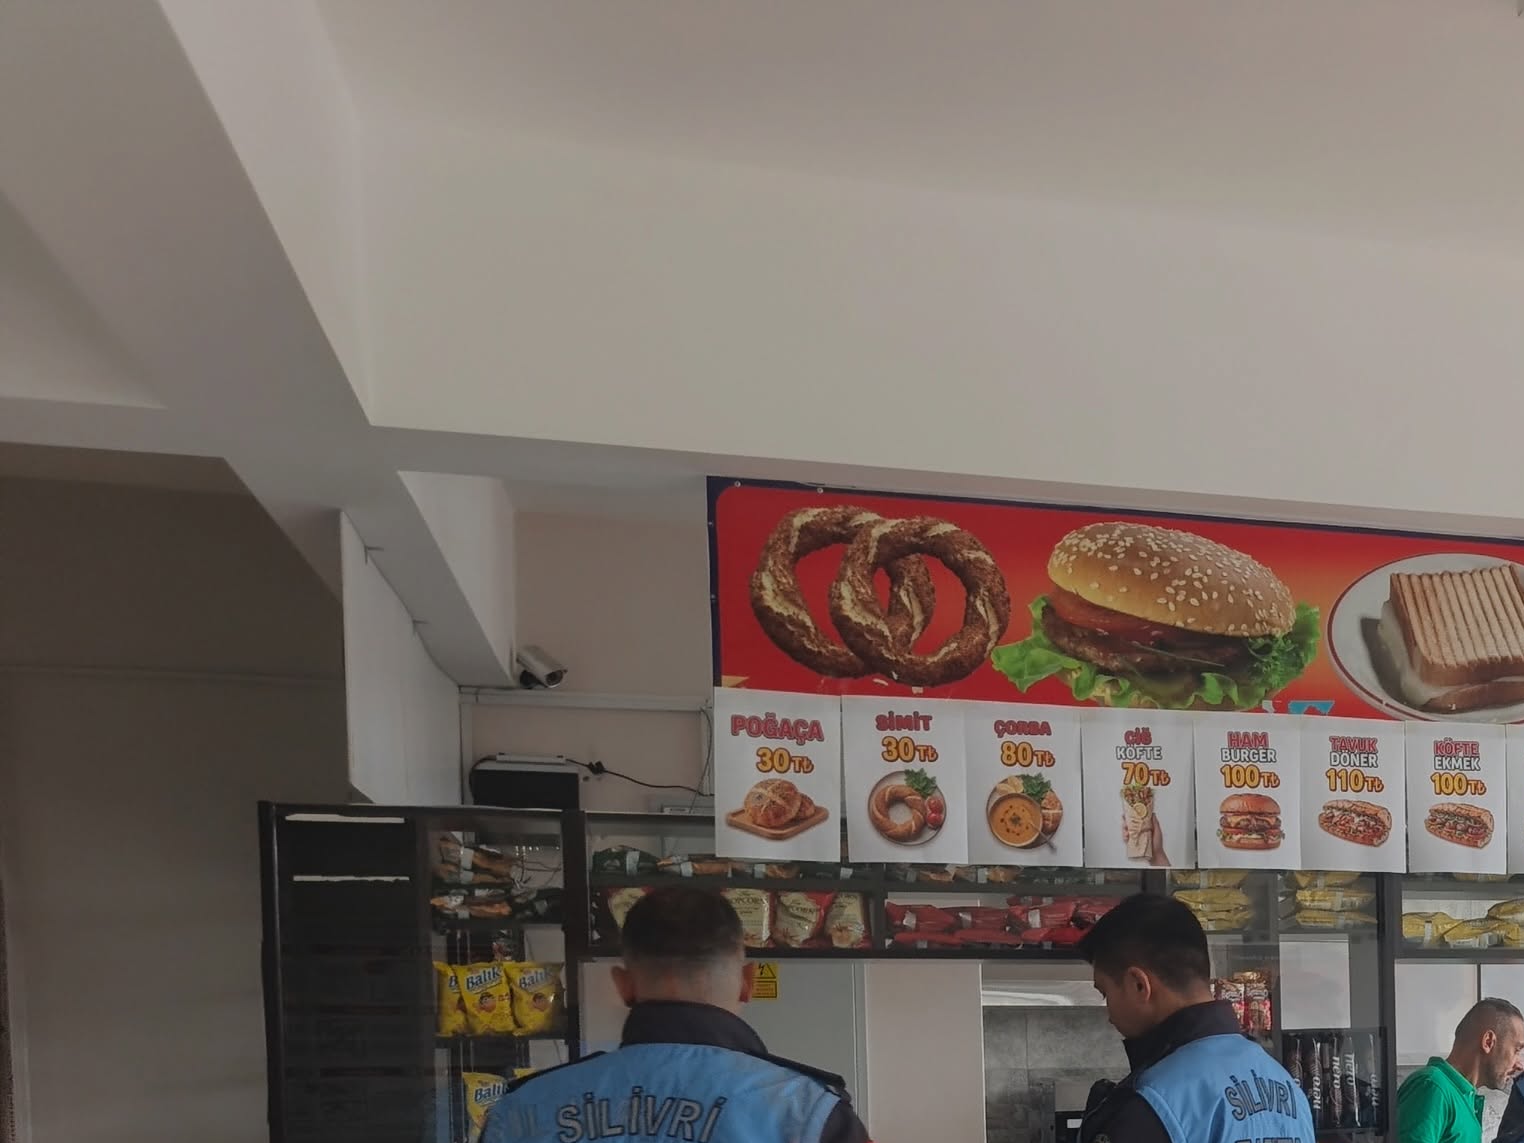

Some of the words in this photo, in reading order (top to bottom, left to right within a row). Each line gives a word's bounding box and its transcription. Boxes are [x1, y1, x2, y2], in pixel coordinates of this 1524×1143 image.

[731, 712, 825, 746] POĞAÇA
[875, 711, 934, 732] SİMİT
[994, 719, 1053, 738] ÇORBA
[1227, 731, 1270, 750] HAM
[1329, 736, 1379, 753] TAVUK
[1433, 737, 1480, 757] KÖFTE
[1115, 743, 1163, 761] KÖFTE
[1220, 747, 1278, 764] BURGER
[1329, 750, 1379, 769] DÖNER
[1433, 754, 1481, 772] EKMEK
[1332, 1056, 1341, 1088] nero
[1225, 1069, 1298, 1121] SİLİVRİ
